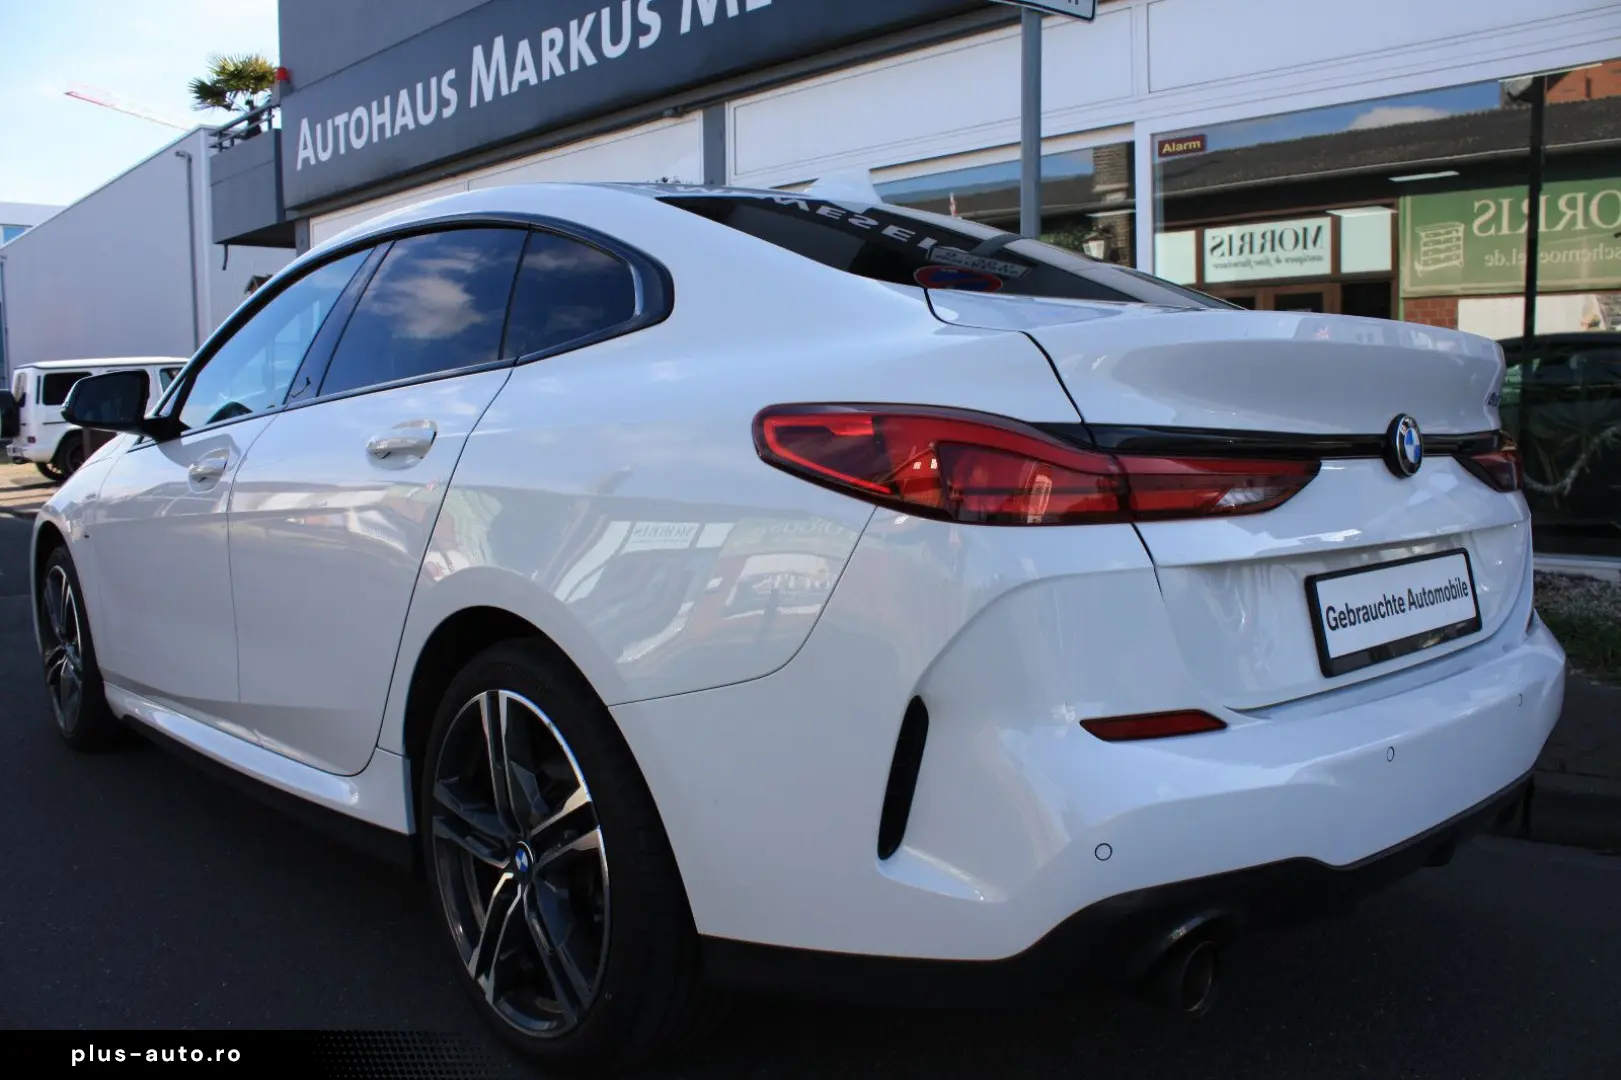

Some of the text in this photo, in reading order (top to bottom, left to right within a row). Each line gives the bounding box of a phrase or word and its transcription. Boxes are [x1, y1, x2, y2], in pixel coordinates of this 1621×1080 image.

[297, 0, 661, 171] AUTOHAUS MARKUS
[1162, 140, 1201, 154] Alarm
[1326, 577, 1469, 631] Gebrauchte Automobile
